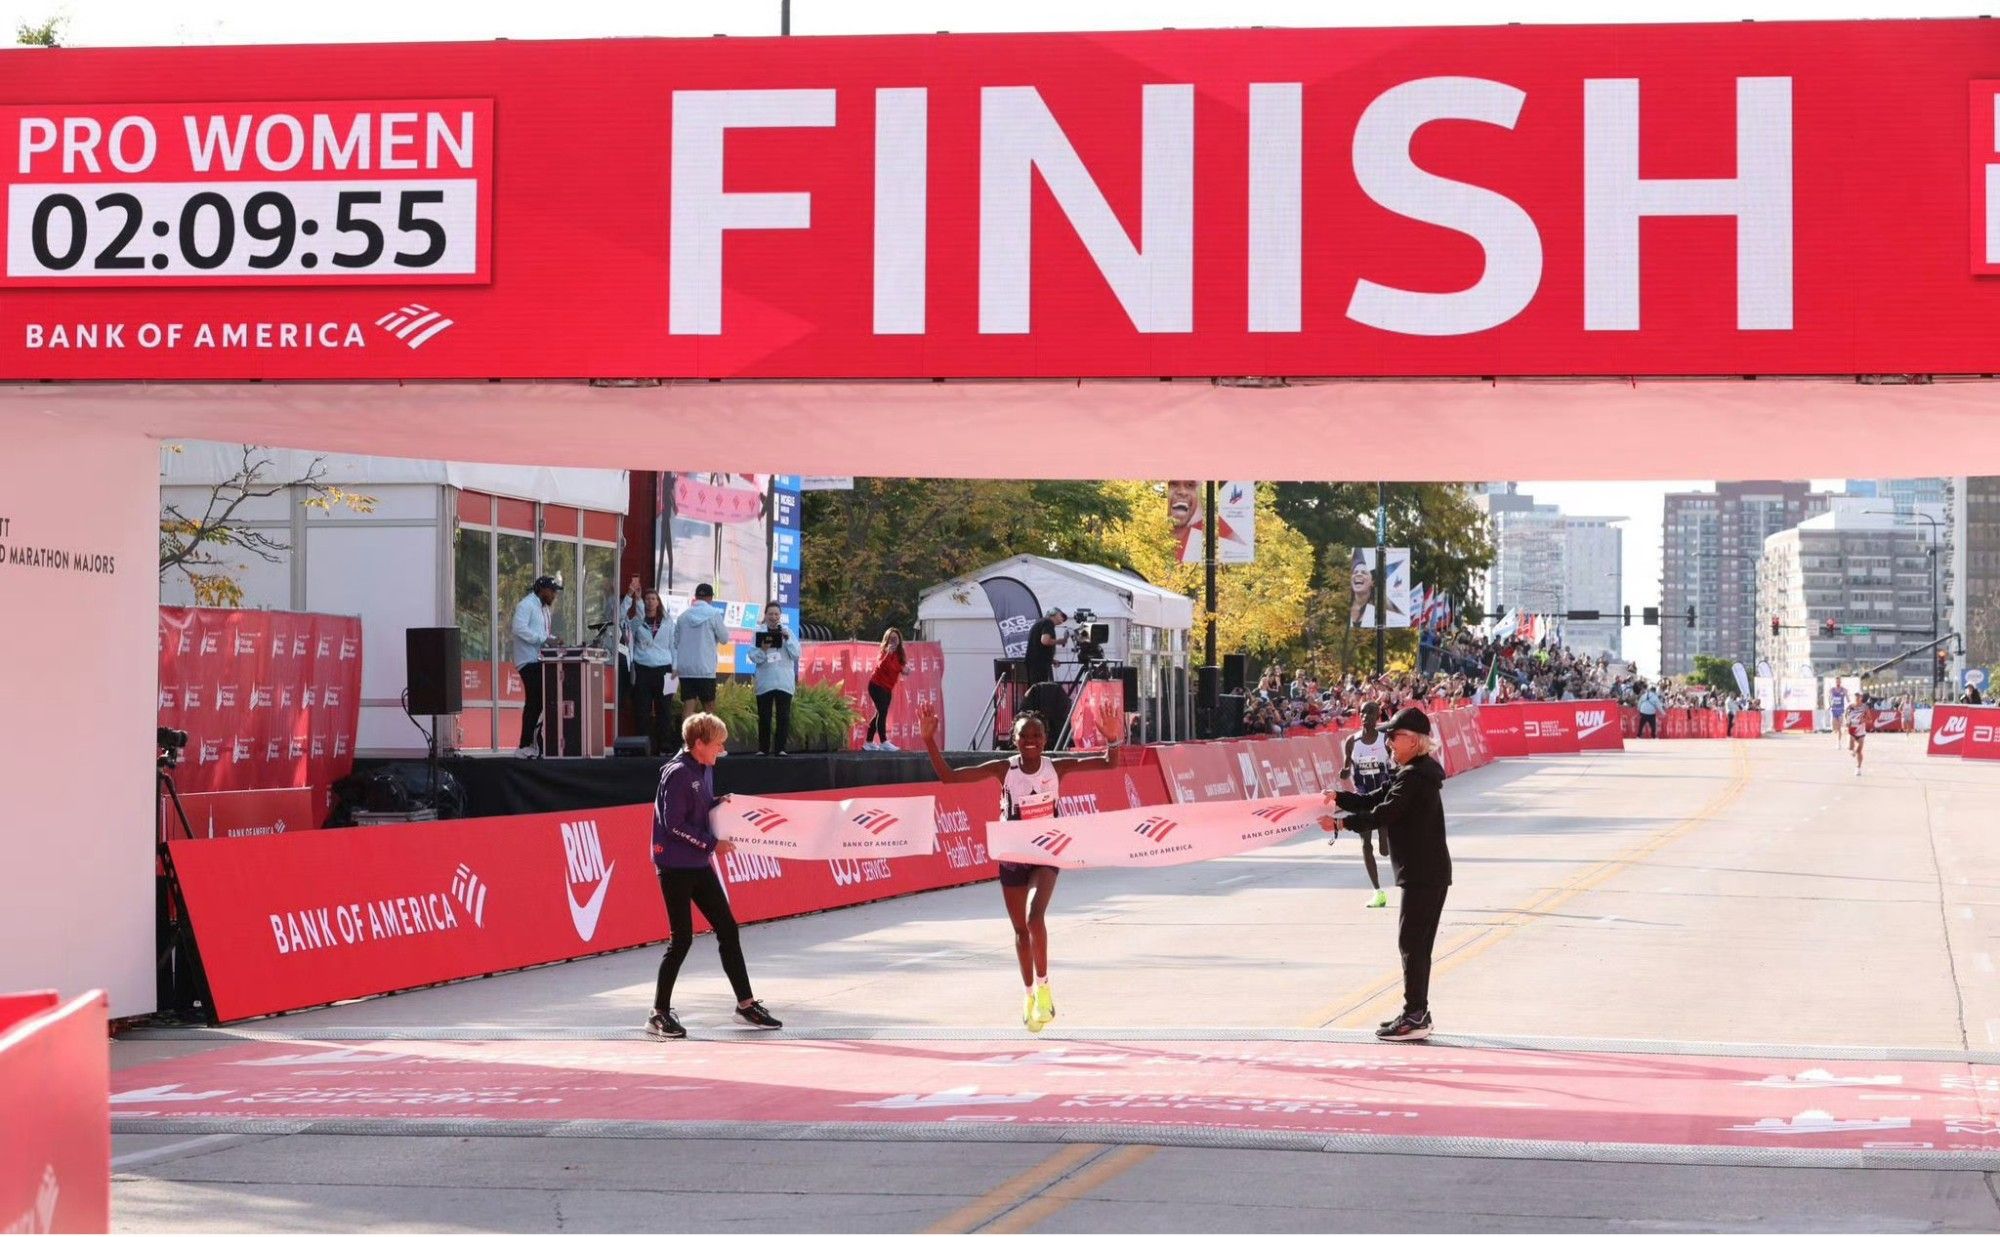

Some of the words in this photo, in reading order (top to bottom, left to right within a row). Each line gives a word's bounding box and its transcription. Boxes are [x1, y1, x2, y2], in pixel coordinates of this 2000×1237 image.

[18, 115, 158, 174] PRO
[183, 111, 475, 173] WOMEN
[668, 74, 1795, 339] FINISH
[30, 189, 448, 271] 02:09:55
[26, 323, 126, 348] BANK
[138, 322, 182, 348] OF
[194, 321, 366, 348] AMERICA
[9, 546, 69, 569] MARATHON
[73, 551, 115, 575] MAJORS
[1575, 710, 1605, 727] RUN
[728, 835, 751, 845] BANK
[762, 839, 798, 848] AMERICA
[875, 839, 909, 847] AMERICA
[1241, 831, 1263, 840] BANK
[559, 819, 604, 884] RUN
[942, 834, 972, 869] Health
[967, 836, 988, 866] Care
[1129, 851, 1148, 859] BANK
[1159, 843, 1193, 855] AMERICA
[861, 858, 891, 882] SERVICES
[269, 907, 338, 955] BANK
[336, 903, 364, 946] OF
[367, 891, 457, 939] AMERICA
[222, 1096, 564, 1104] Marathon
[249, 1090, 519, 1099] Chicago
[1073, 1093, 1359, 1108] Chicago
[1058, 1100, 1420, 1118] Marathon
